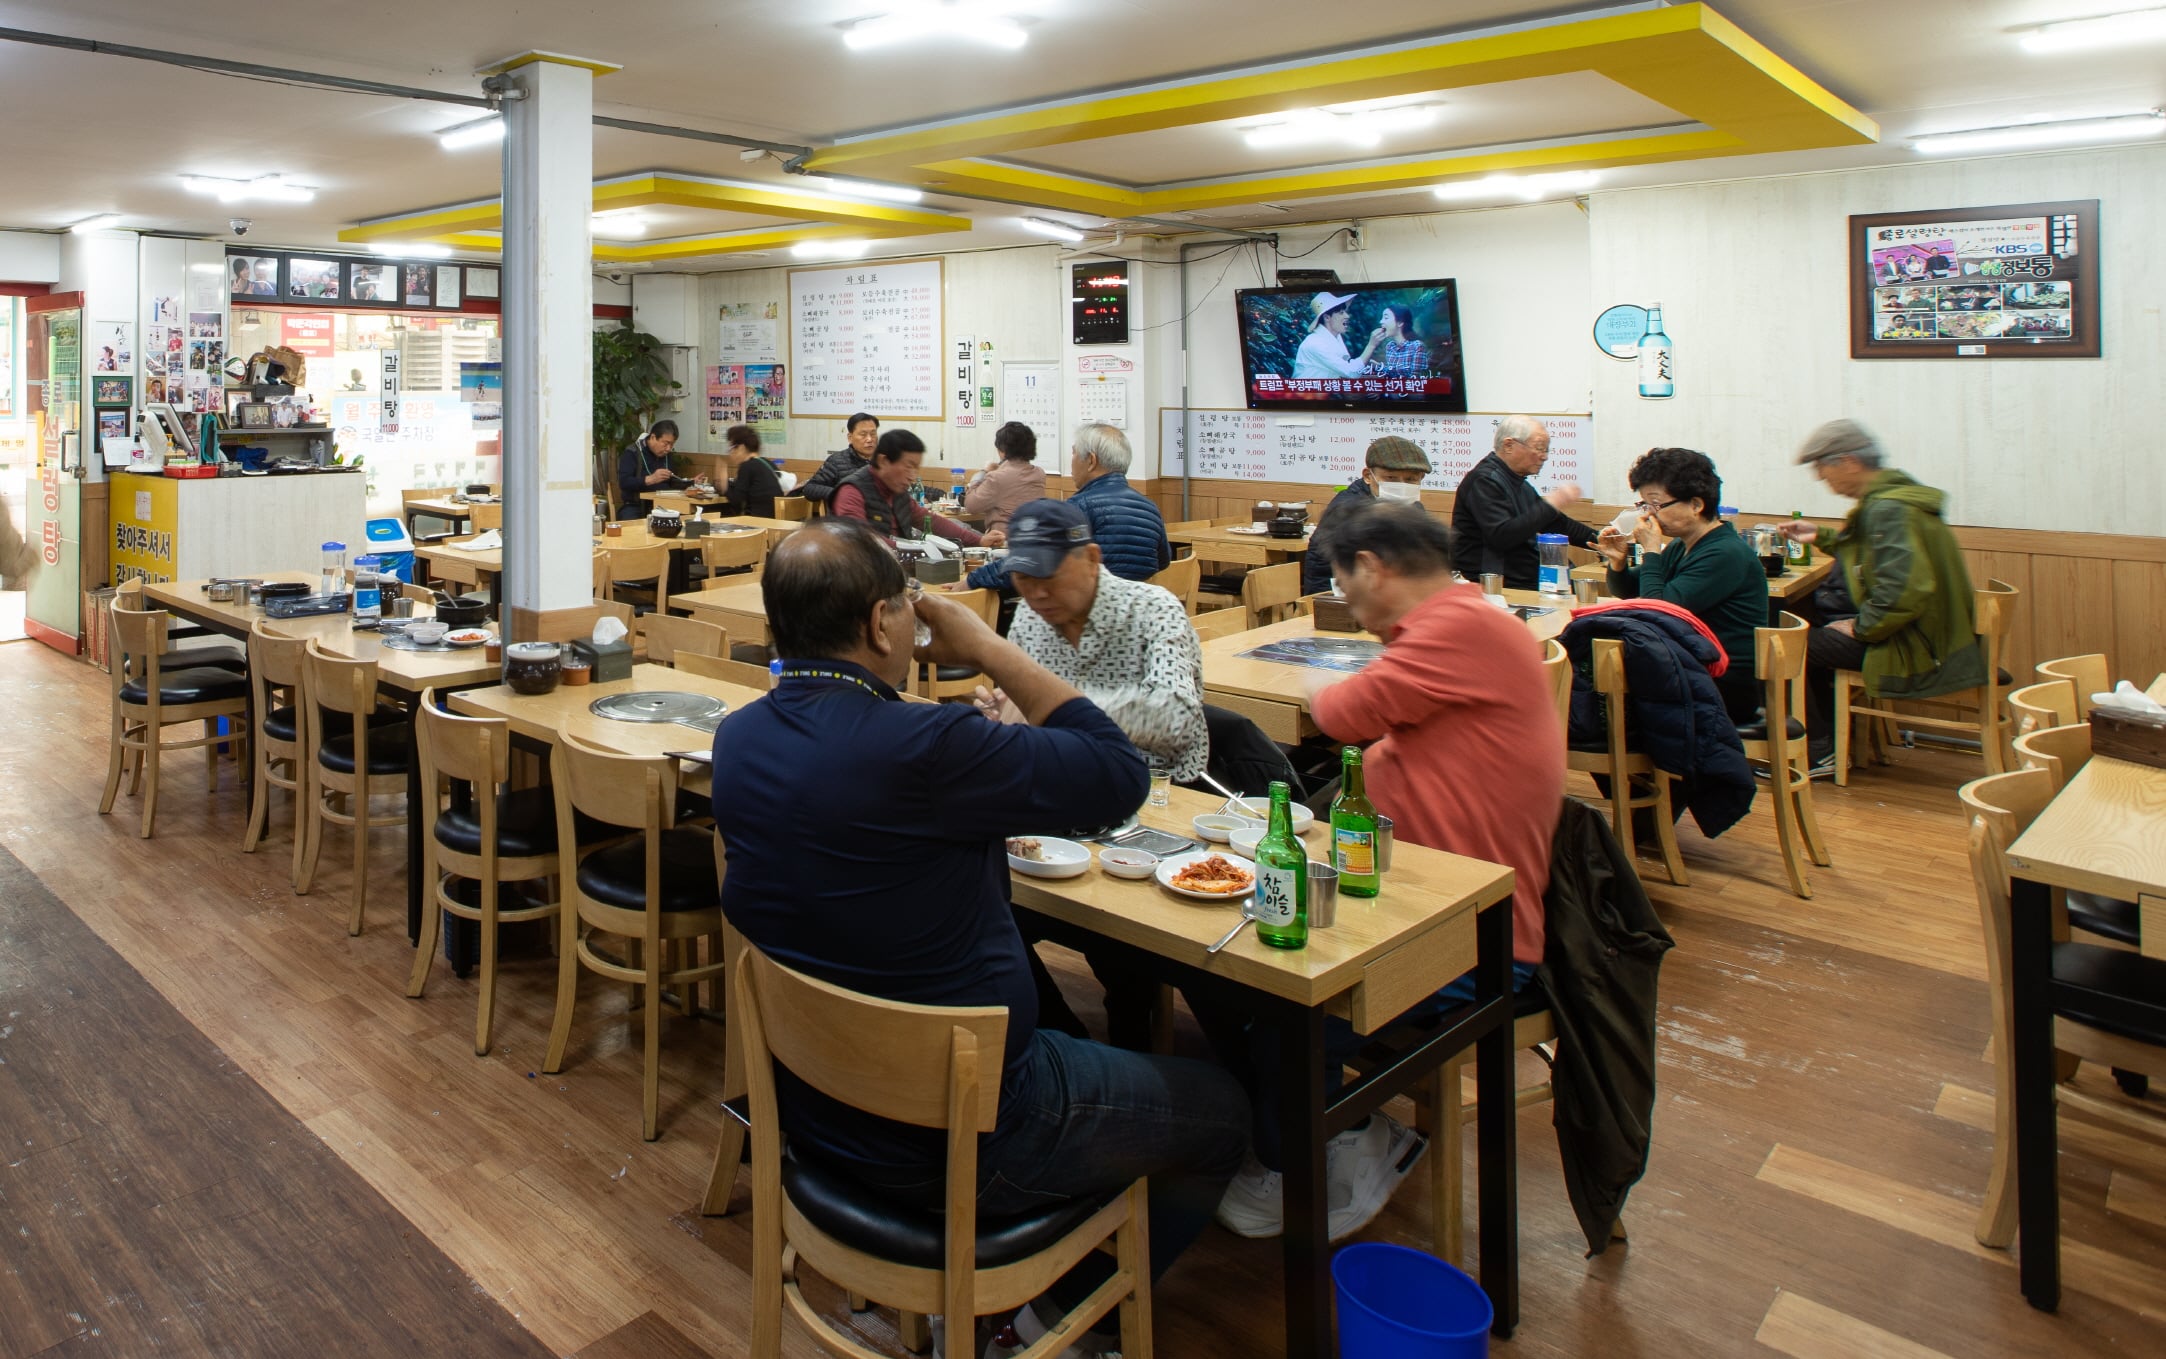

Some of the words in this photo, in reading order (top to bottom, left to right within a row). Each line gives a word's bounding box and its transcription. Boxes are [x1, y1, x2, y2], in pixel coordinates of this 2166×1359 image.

[1996, 244, 2027, 254] KBS
[846, 274, 878, 284] 차림표
[958, 341, 973, 409] 갈비탕
[1025, 376, 1035, 386] 11
[385, 355, 398, 418] 갈비탕
[1259, 380, 1284, 392] 트럼프
[1285, 379, 1322, 392] "부정부패
[1323, 380, 1340, 392] 상황
[1342, 380, 1350, 391] 볼
[1353, 380, 1363, 391] 수
[1364, 380, 1383, 392] 있는
[1384, 380, 1403, 392] 선거
[361, 428, 396, 443] 국일
[1279, 435, 1316, 443] 도가니탕
[43, 414, 60, 564] 설렁탕
[117, 523, 170, 562] 찾아주셔서
